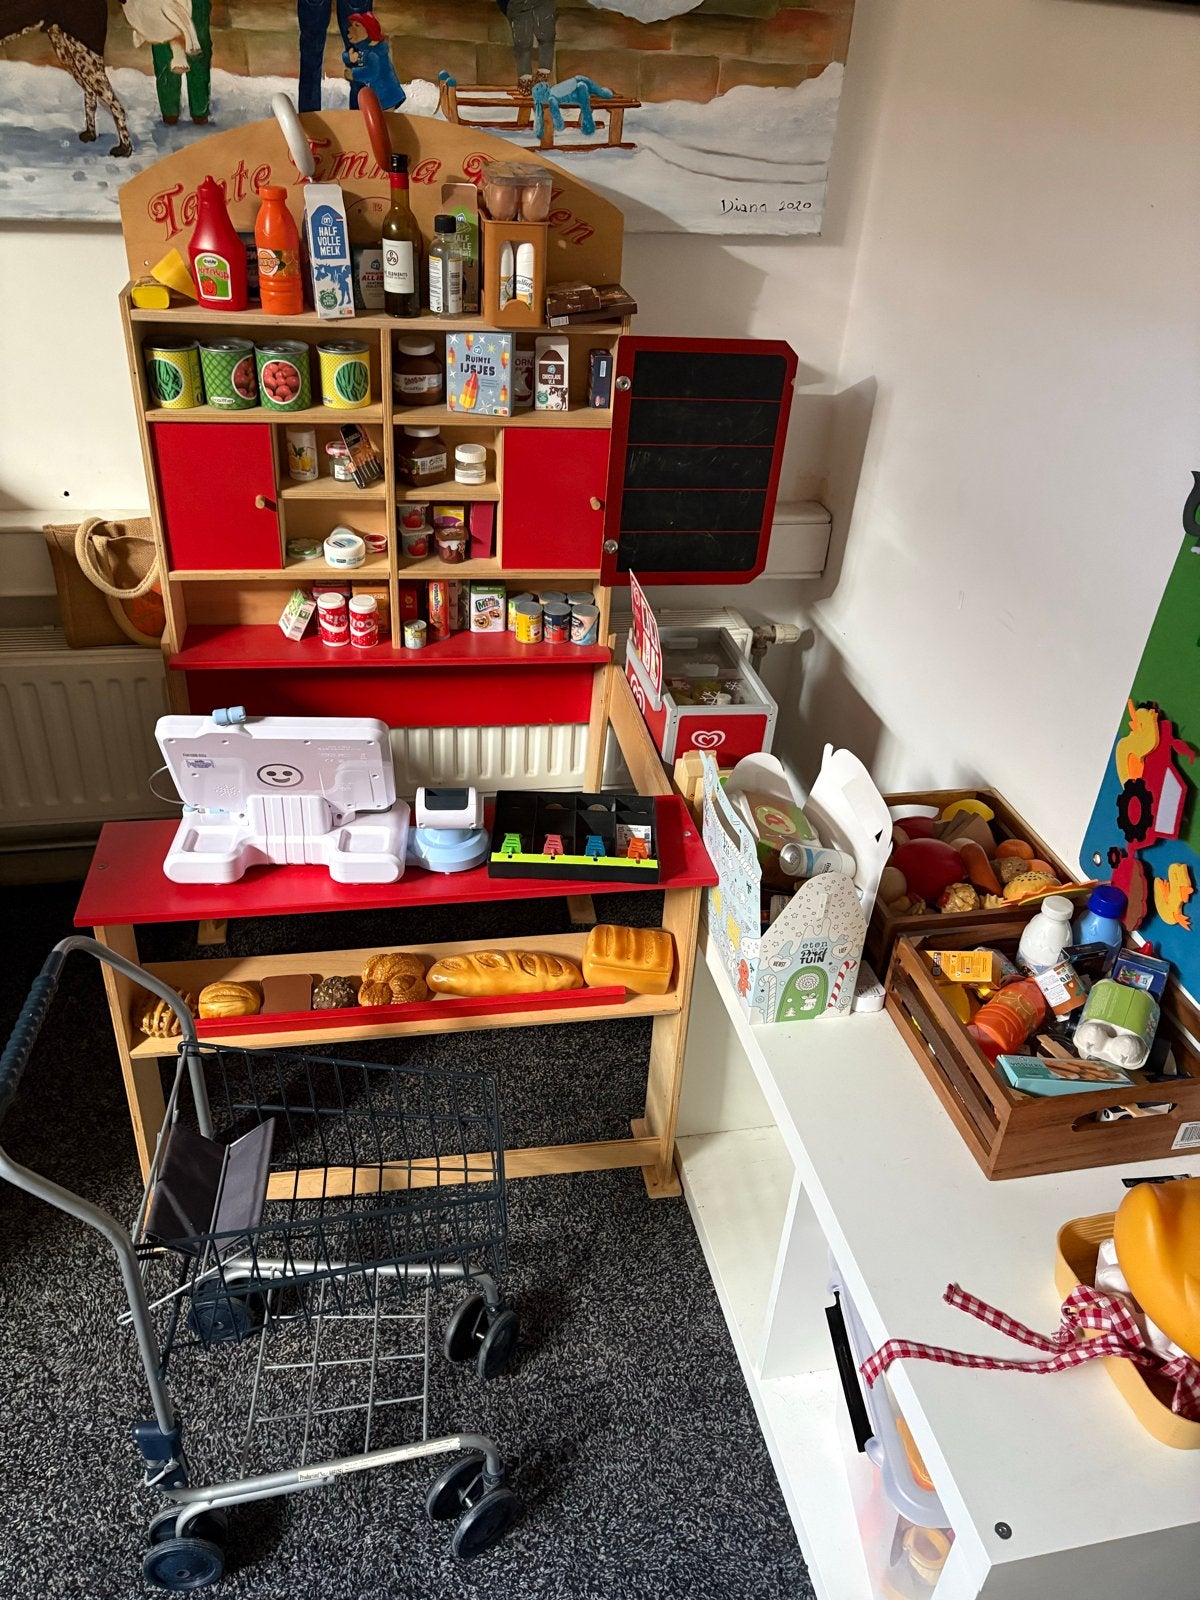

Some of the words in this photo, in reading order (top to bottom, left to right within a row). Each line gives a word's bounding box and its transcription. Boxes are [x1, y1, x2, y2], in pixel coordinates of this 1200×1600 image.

[720, 198, 767, 215] Diana
[779, 200, 812, 212] 2020
[318, 226, 338, 237] HALF
[317, 236, 341, 246] VOLLE
[320, 246, 341, 256] MELK
[465, 354, 491, 364] RUIMTE
[460, 363, 496, 376] IJSJES
[802, 941, 828, 949] eten
[800, 956, 825, 964] TUIN
